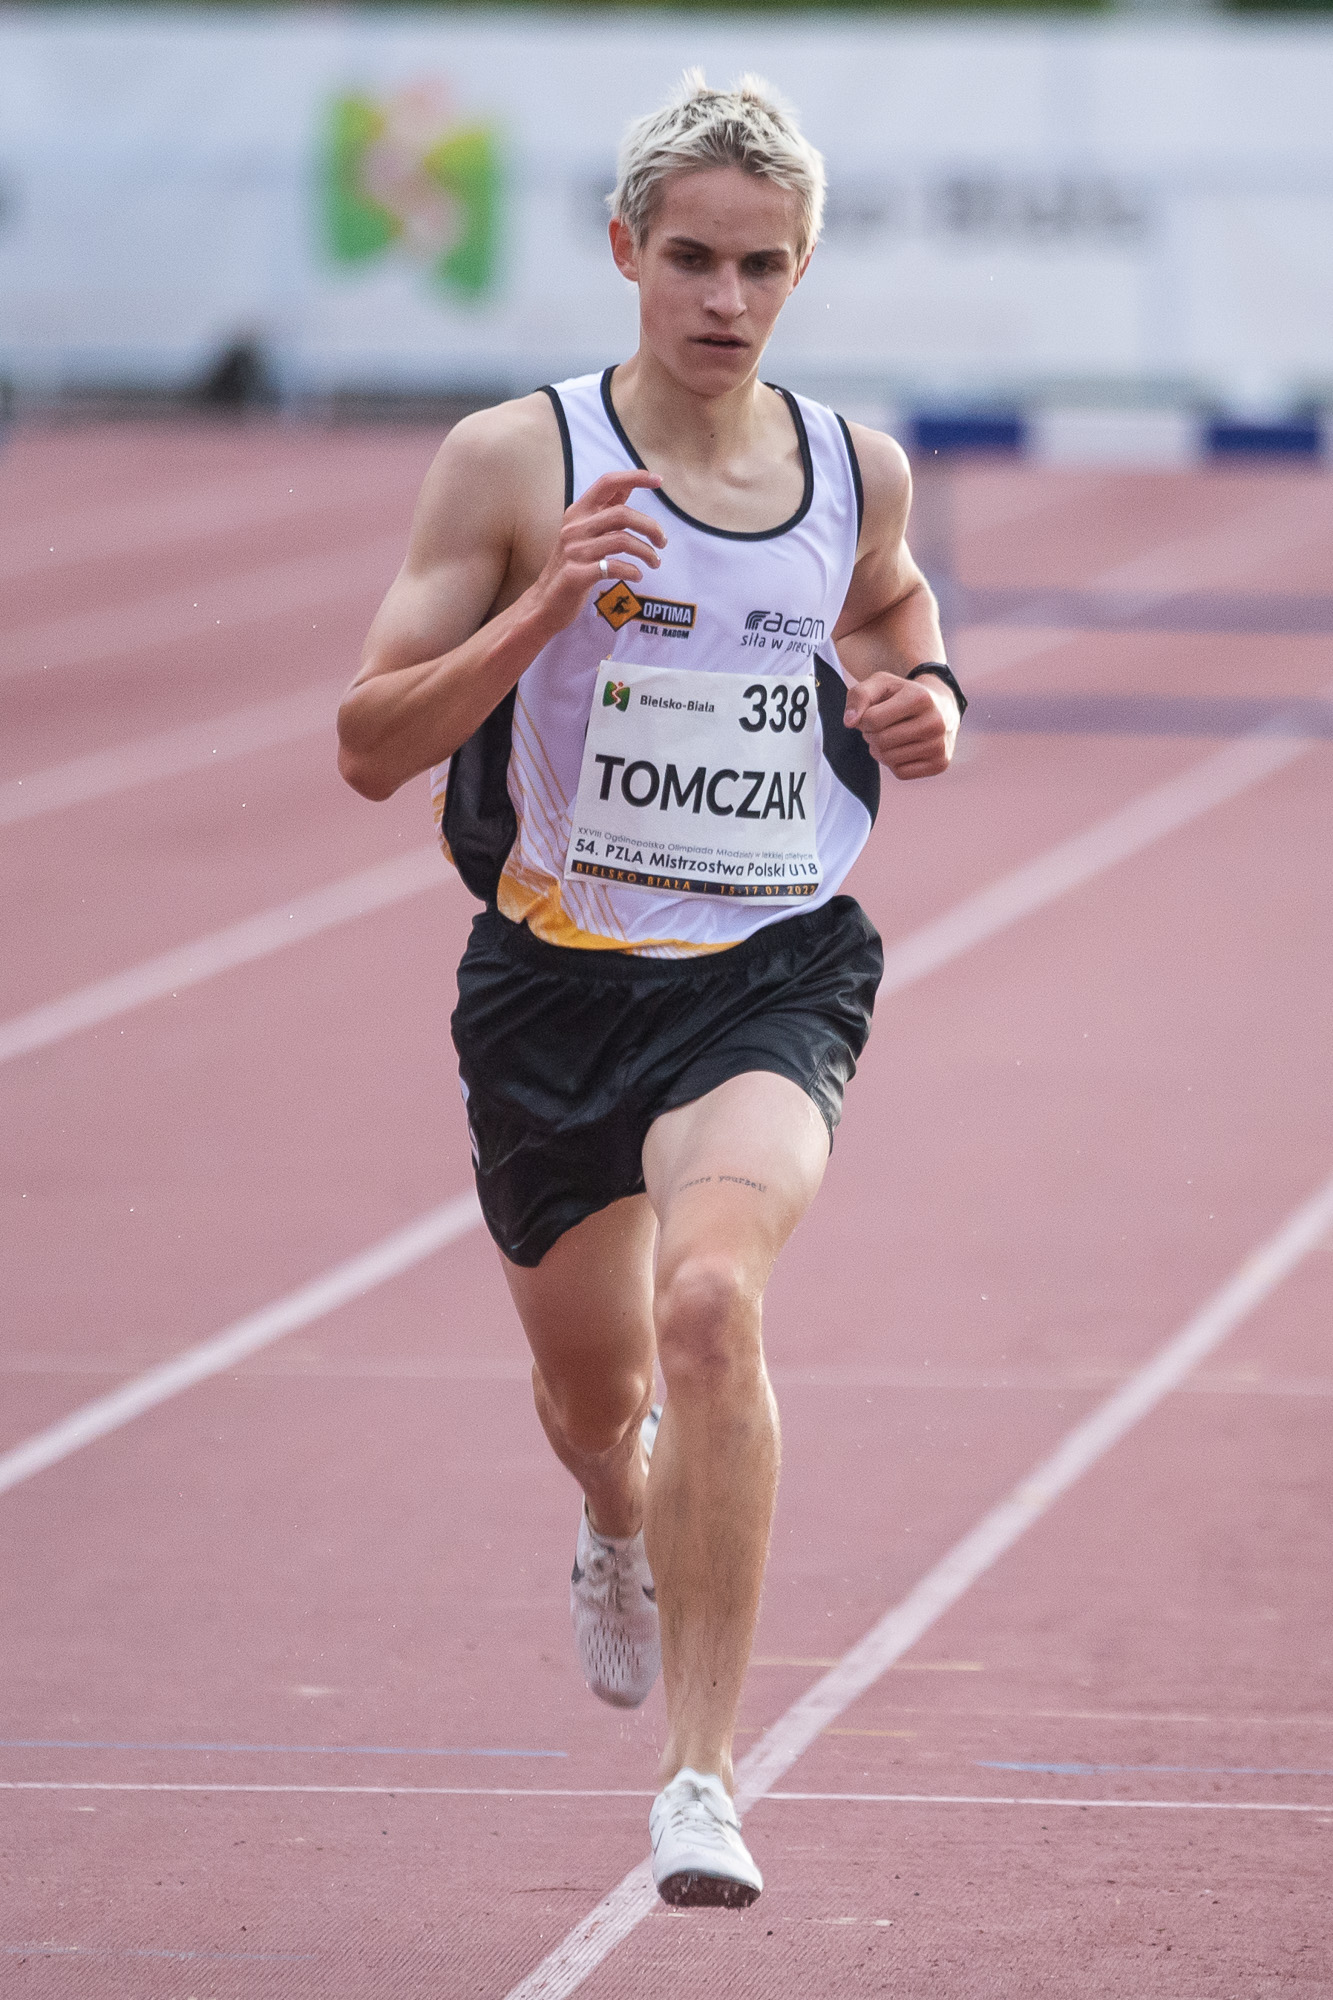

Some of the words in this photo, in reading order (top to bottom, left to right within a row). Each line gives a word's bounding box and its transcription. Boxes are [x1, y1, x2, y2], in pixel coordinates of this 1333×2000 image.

[643, 602, 691, 624] OPTIMA
[745, 610, 825, 640] radom
[662, 628, 689, 639] RADOM
[741, 632, 766, 648] siła
[771, 638, 783, 650] w
[738, 684, 810, 733] 338
[595, 753, 806, 820] TOMCZAK
[578, 827, 602, 838] XXVIII
[604, 832, 665, 850] Ogólnopolska
[668, 843, 713, 856] Olimpiada
[575, 838, 598, 856] 54.
[605, 844, 643, 865] PZLA
[649, 852, 744, 876] Mistrzostwa
[747, 862, 785, 877] Polski
[789, 863, 818, 877] U18
